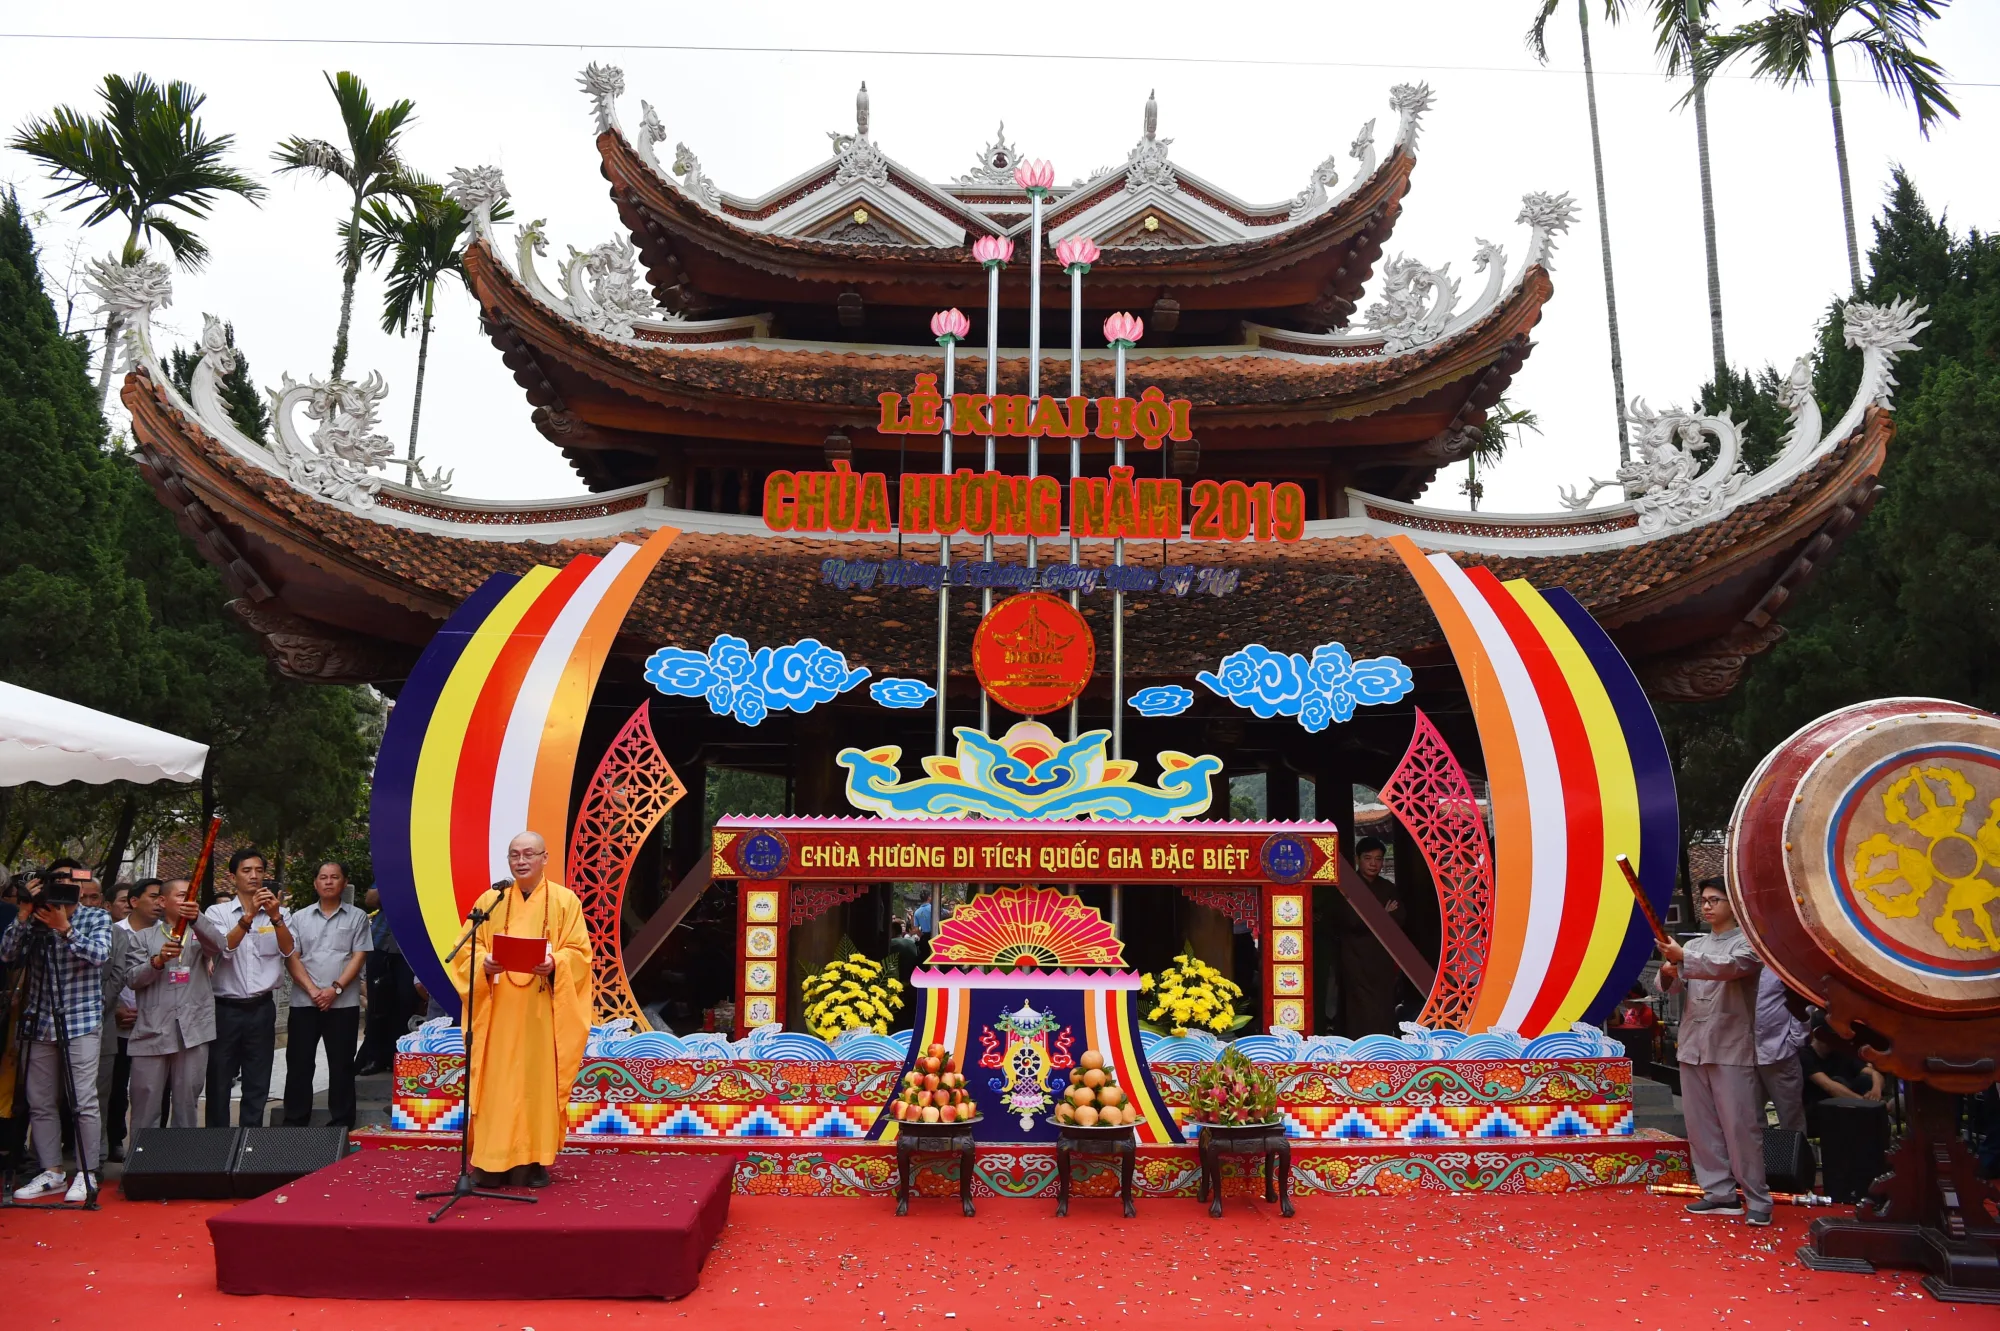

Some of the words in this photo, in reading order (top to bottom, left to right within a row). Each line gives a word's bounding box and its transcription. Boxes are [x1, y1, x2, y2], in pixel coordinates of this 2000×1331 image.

[877, 373, 942, 434] LỄ
[951, 393, 1089, 437] KHAI
[1095, 386, 1192, 449] HỘI
[763, 460, 891, 533] CHÙA
[900, 468, 1060, 538] HƯƠNG
[1070, 466, 1181, 539] NĂM
[1190, 480, 1305, 543] 2019
[821, 557, 879, 590] Ngày
[950, 560, 968, 586] 6
[969, 559, 1035, 592] Tháng
[1041, 564, 1100, 595] Giêng
[1104, 565, 1157, 594] Năm
[801, 841, 860, 867] CHÙA
[867, 843, 944, 868] HƯƠNG
[953, 847, 974, 868] DI
[981, 842, 1031, 868] TÍCH
[1040, 840, 1099, 872] QUỐC
[1108, 848, 1143, 868] GIA
[1151, 843, 1194, 874] ĐẶC
[1203, 844, 1249, 874] BIỆT
